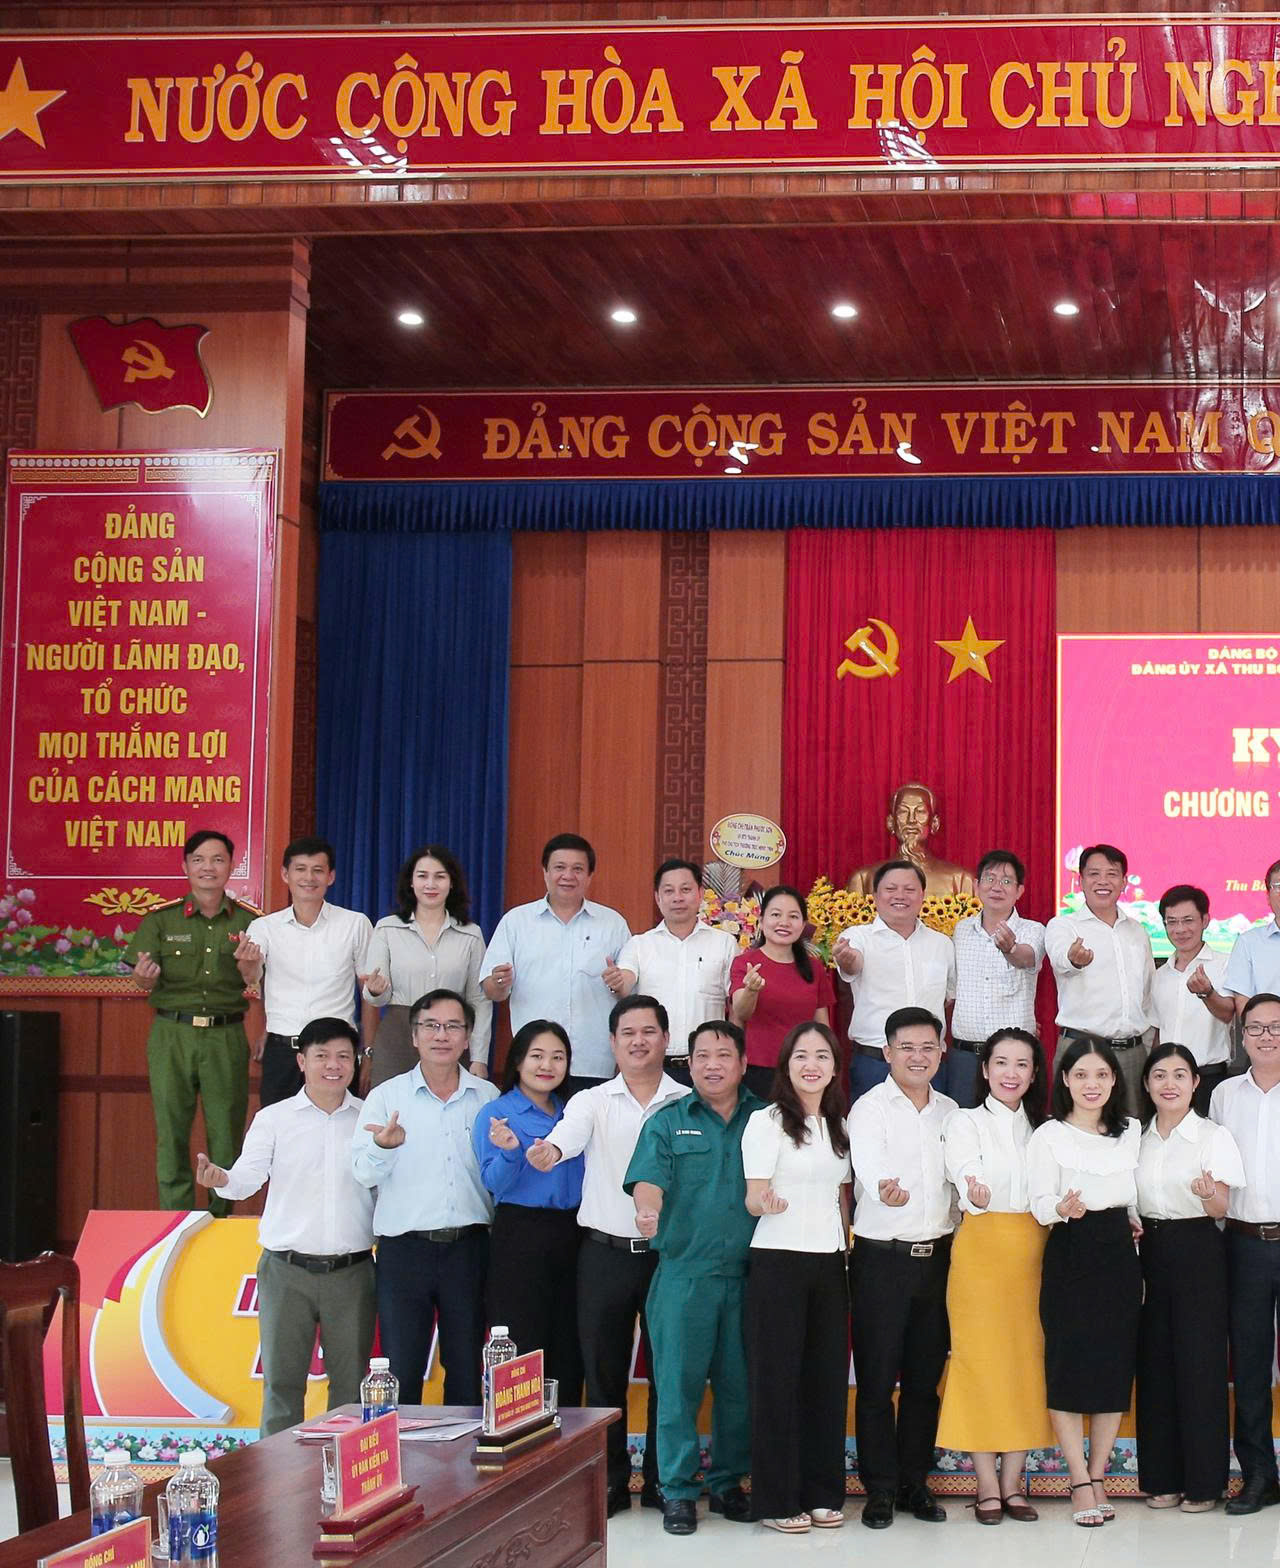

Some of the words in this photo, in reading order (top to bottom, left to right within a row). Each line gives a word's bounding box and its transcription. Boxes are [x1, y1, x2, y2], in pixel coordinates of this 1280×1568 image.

[125, 53, 304, 145] NƯỚC
[336, 53, 516, 152] CỘNG
[540, 48, 683, 133] HÒA
[710, 51, 816, 129] XÃ
[848, 47, 968, 142] HỘI
[990, 37, 1136, 128] CHỦ
[484, 402, 630, 462] ĐẢNG
[648, 402, 787, 469] CỘNG
[807, 396, 918, 458] SẢN
[941, 399, 1077, 464] VIỆT
[1098, 412, 1222, 454] NAM
[105, 503, 175, 539] ĐẢNG
[73, 552, 143, 589] CỘNG
[152, 548, 204, 582] SẢN
[68, 594, 121, 632] VIỆT
[129, 600, 189, 626] NAM
[26, 639, 104, 671] NGƯỜI
[113, 637, 179, 671] LÃNH
[188, 643, 245, 676] ĐẠO,
[1232, 663, 1264, 675] THU
[81, 677, 112, 714] TỔ
[119, 684, 187, 714] CHỨC
[38, 732, 87, 765] MỌI
[96, 722, 178, 759] THẮNG
[189, 729, 227, 765] LỢI
[28, 768, 79, 804] CỦA
[87, 771, 156, 804] CÁCH
[164, 776, 241, 808] MẠNG
[1163, 786, 1270, 817] CHƯƠNG
[65, 815, 118, 853] VIỆT
[126, 821, 185, 847] NAM
[1226, 880, 1248, 892] Thu
